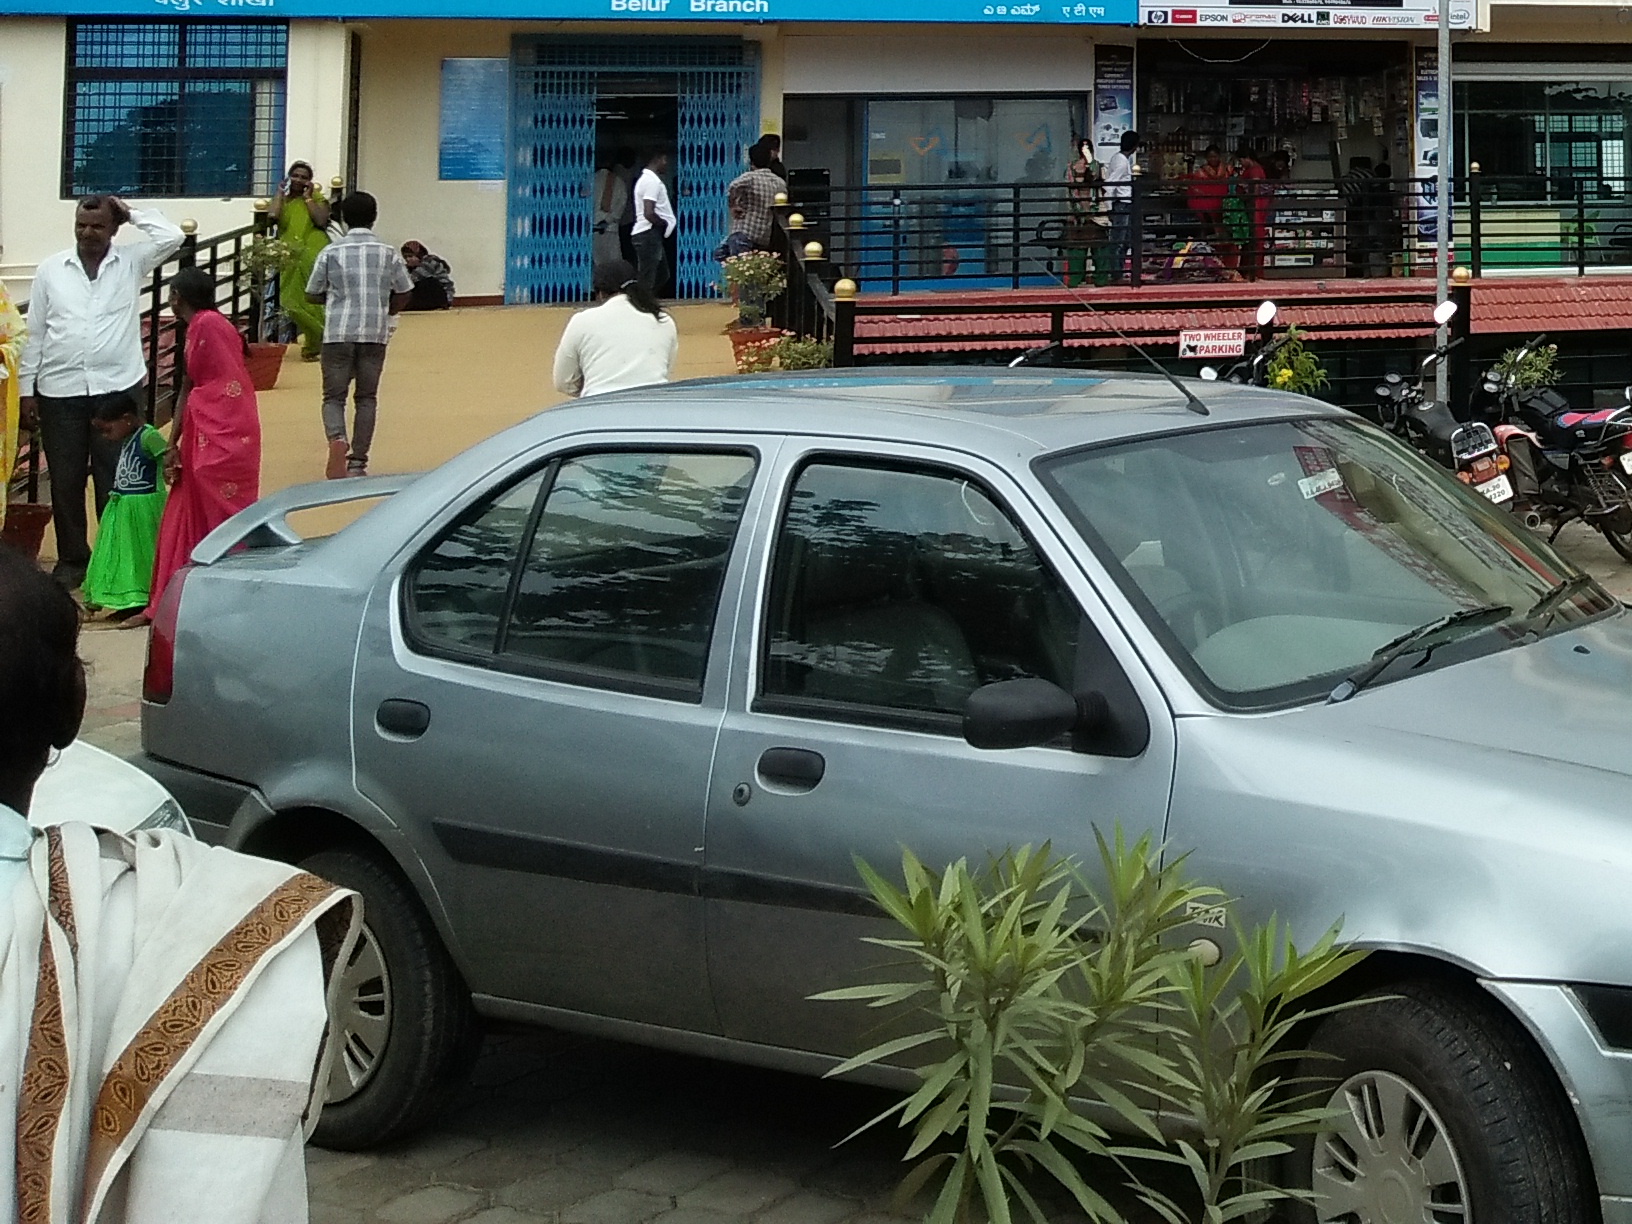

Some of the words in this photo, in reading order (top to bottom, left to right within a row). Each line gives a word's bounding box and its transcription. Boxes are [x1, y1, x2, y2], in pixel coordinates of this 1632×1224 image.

[1200, 13, 1228, 22] EPSON
[1281, 12, 1315, 23] DELL
[1183, 333, 1201, 342] TWO
[1203, 332, 1243, 341] WHEELER
[1199, 344, 1242, 354] PARKING
